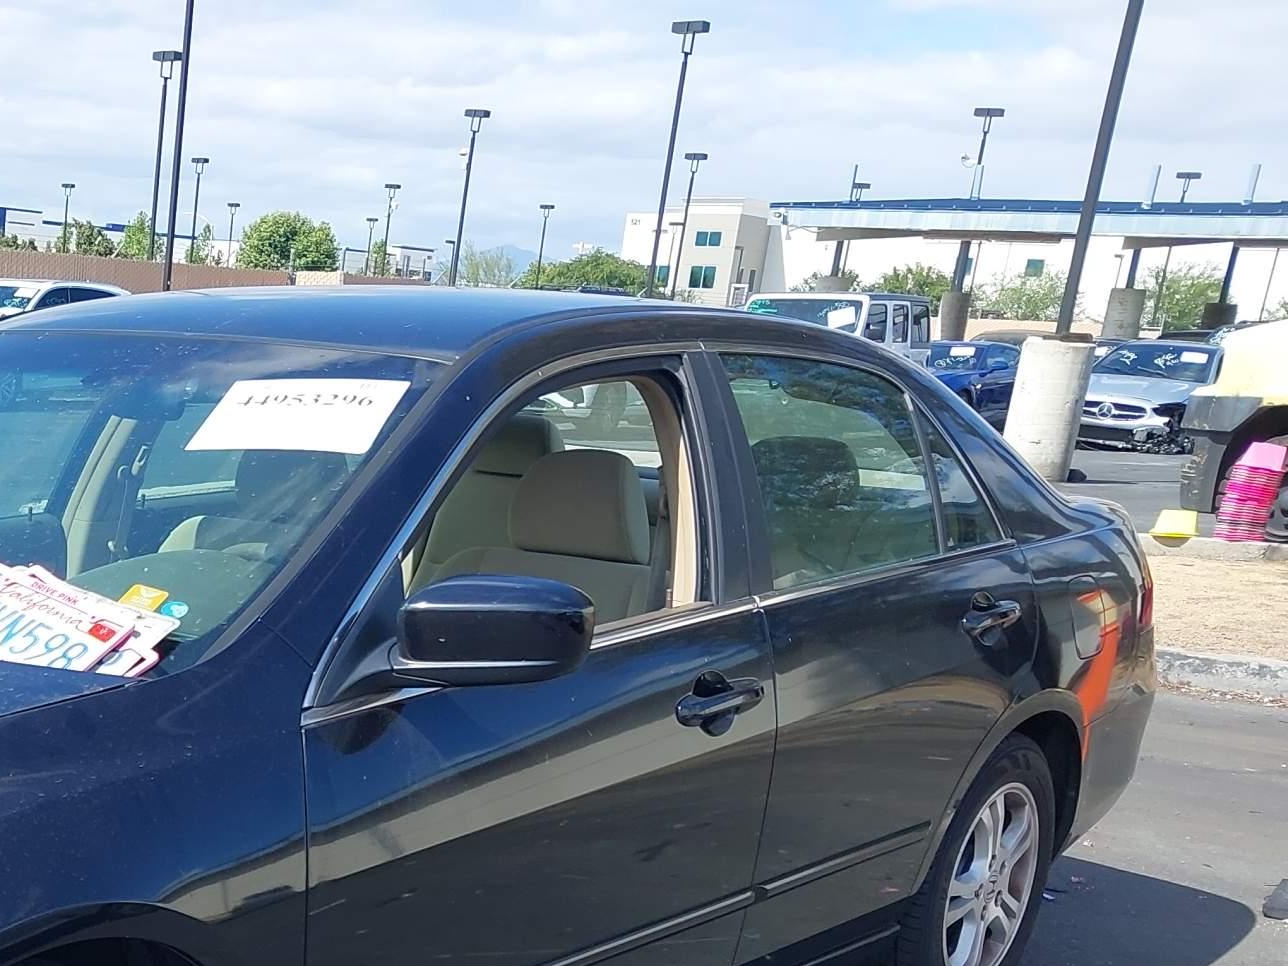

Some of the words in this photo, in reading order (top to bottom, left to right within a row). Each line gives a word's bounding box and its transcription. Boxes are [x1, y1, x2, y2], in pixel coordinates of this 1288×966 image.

[0, 578, 89, 634] California
[31, 581, 58, 597] DRIVE
[57, 592, 80, 606] PINK
